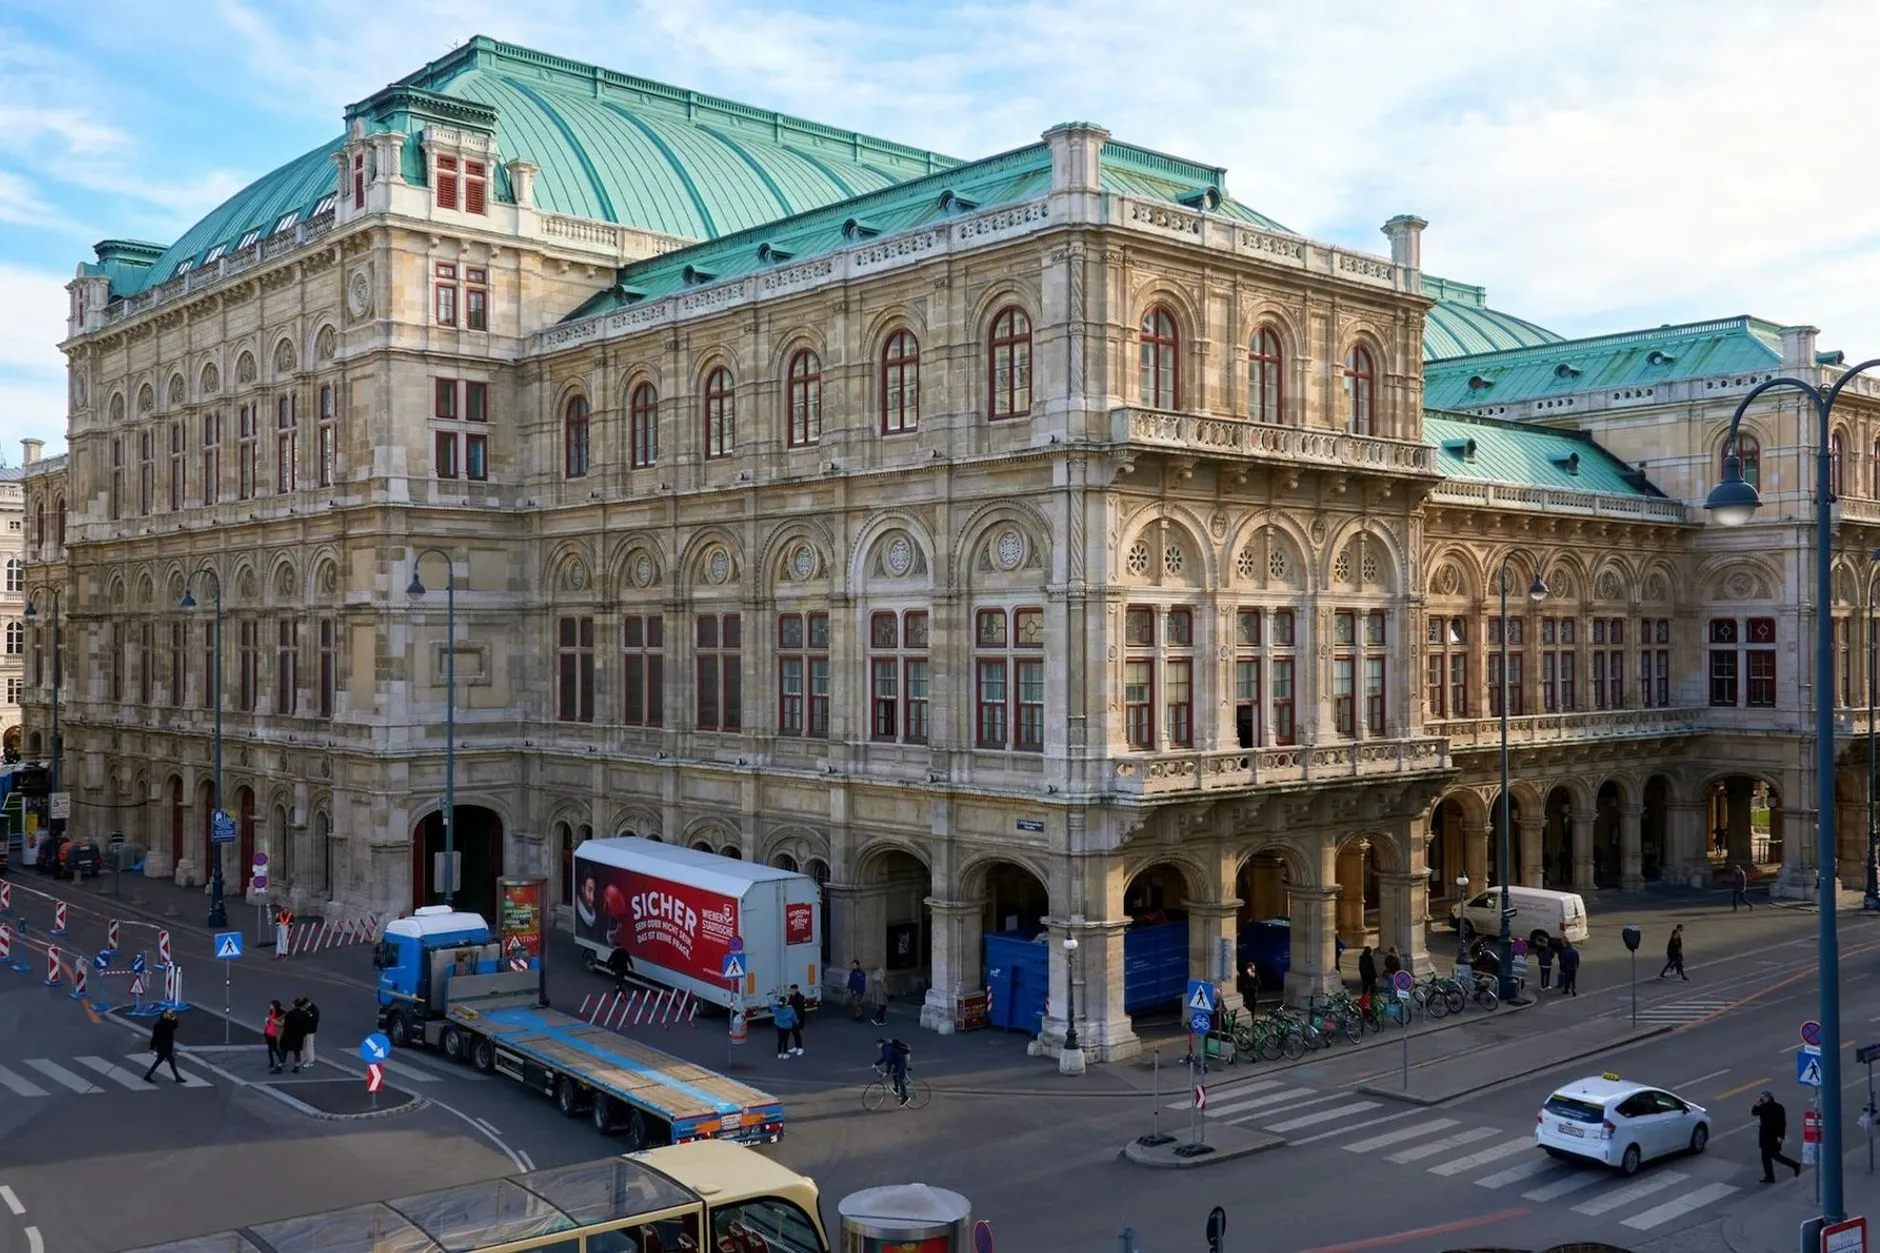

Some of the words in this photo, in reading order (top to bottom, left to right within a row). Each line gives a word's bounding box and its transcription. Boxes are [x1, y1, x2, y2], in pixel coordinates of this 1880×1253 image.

[631, 891, 697, 937] SICHER
[702, 908, 725, 923] WIENER
[635, 920, 647, 932] SEIN
[647, 919, 661, 929] ODER
[662, 921, 679, 935] NICHT
[637, 933, 647, 944] DAS
[647, 931, 655, 939] IST
[656, 931, 672, 945] KEINE
